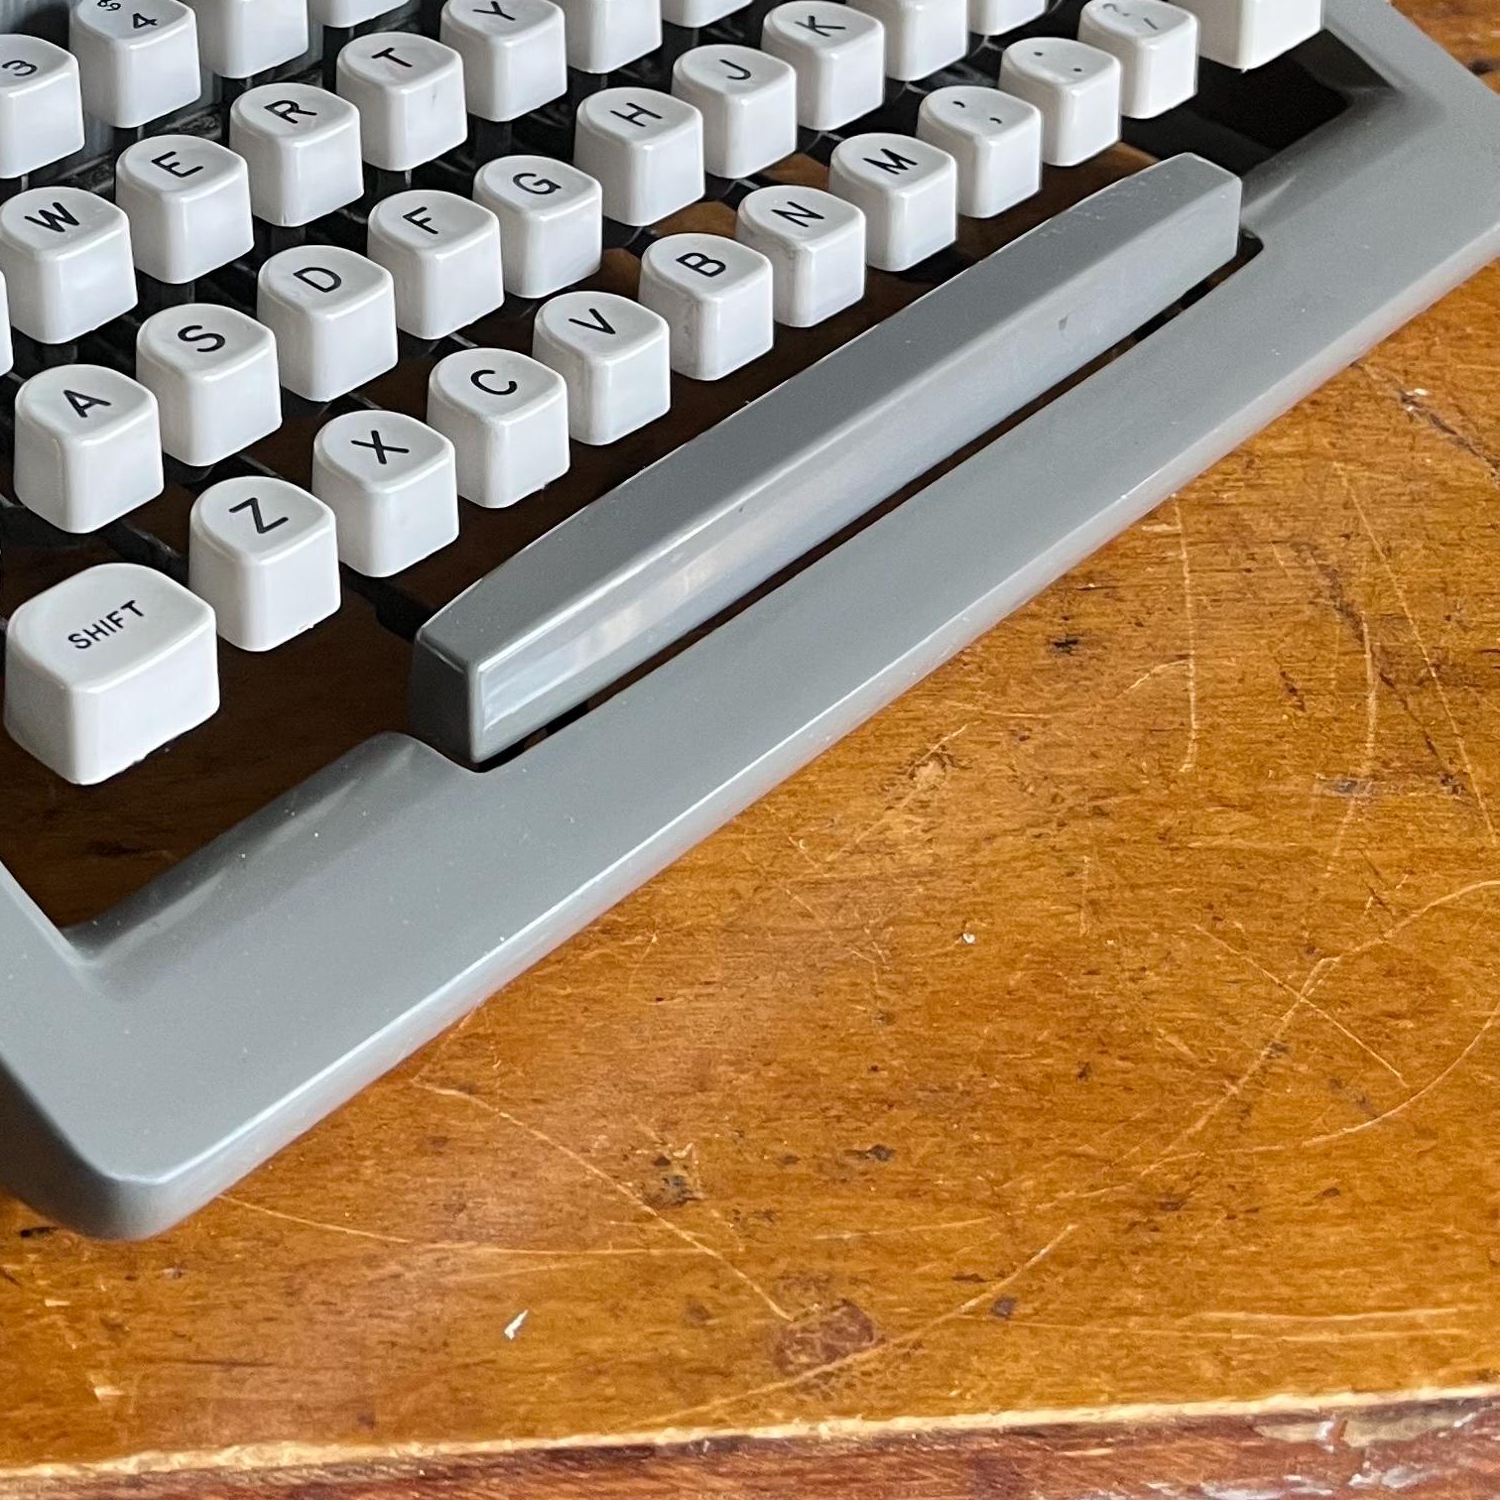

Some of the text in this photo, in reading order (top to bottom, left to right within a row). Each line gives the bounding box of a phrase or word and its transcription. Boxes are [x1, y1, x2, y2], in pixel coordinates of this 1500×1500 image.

[132, 12, 158, 30] 4
[472, 0, 517, 22] Y
[794, 15, 847, 38] K
[1, 59, 38, 77] 3
[371, 47, 413, 68] T
[719, 58, 752, 81] J
[263, 99, 318, 125] R
[609, 102, 664, 128] H
[150, 150, 205, 179] E
[862, 148, 919, 176] M
[512, 172, 563, 196] G
[23, 201, 81, 233] W
[402, 206, 439, 235] F
[770, 200, 825, 228] N
[675, 252, 727, 278] B
[292, 266, 342, 294] D
[568, 307, 617, 335] V
[177, 324, 226, 353] S
[470, 369, 518, 396] C
[62, 389, 112, 419] A
[350, 429, 410, 465] X
[228, 497, 290, 535] Z
[67, 599, 145, 650] SHIFT
